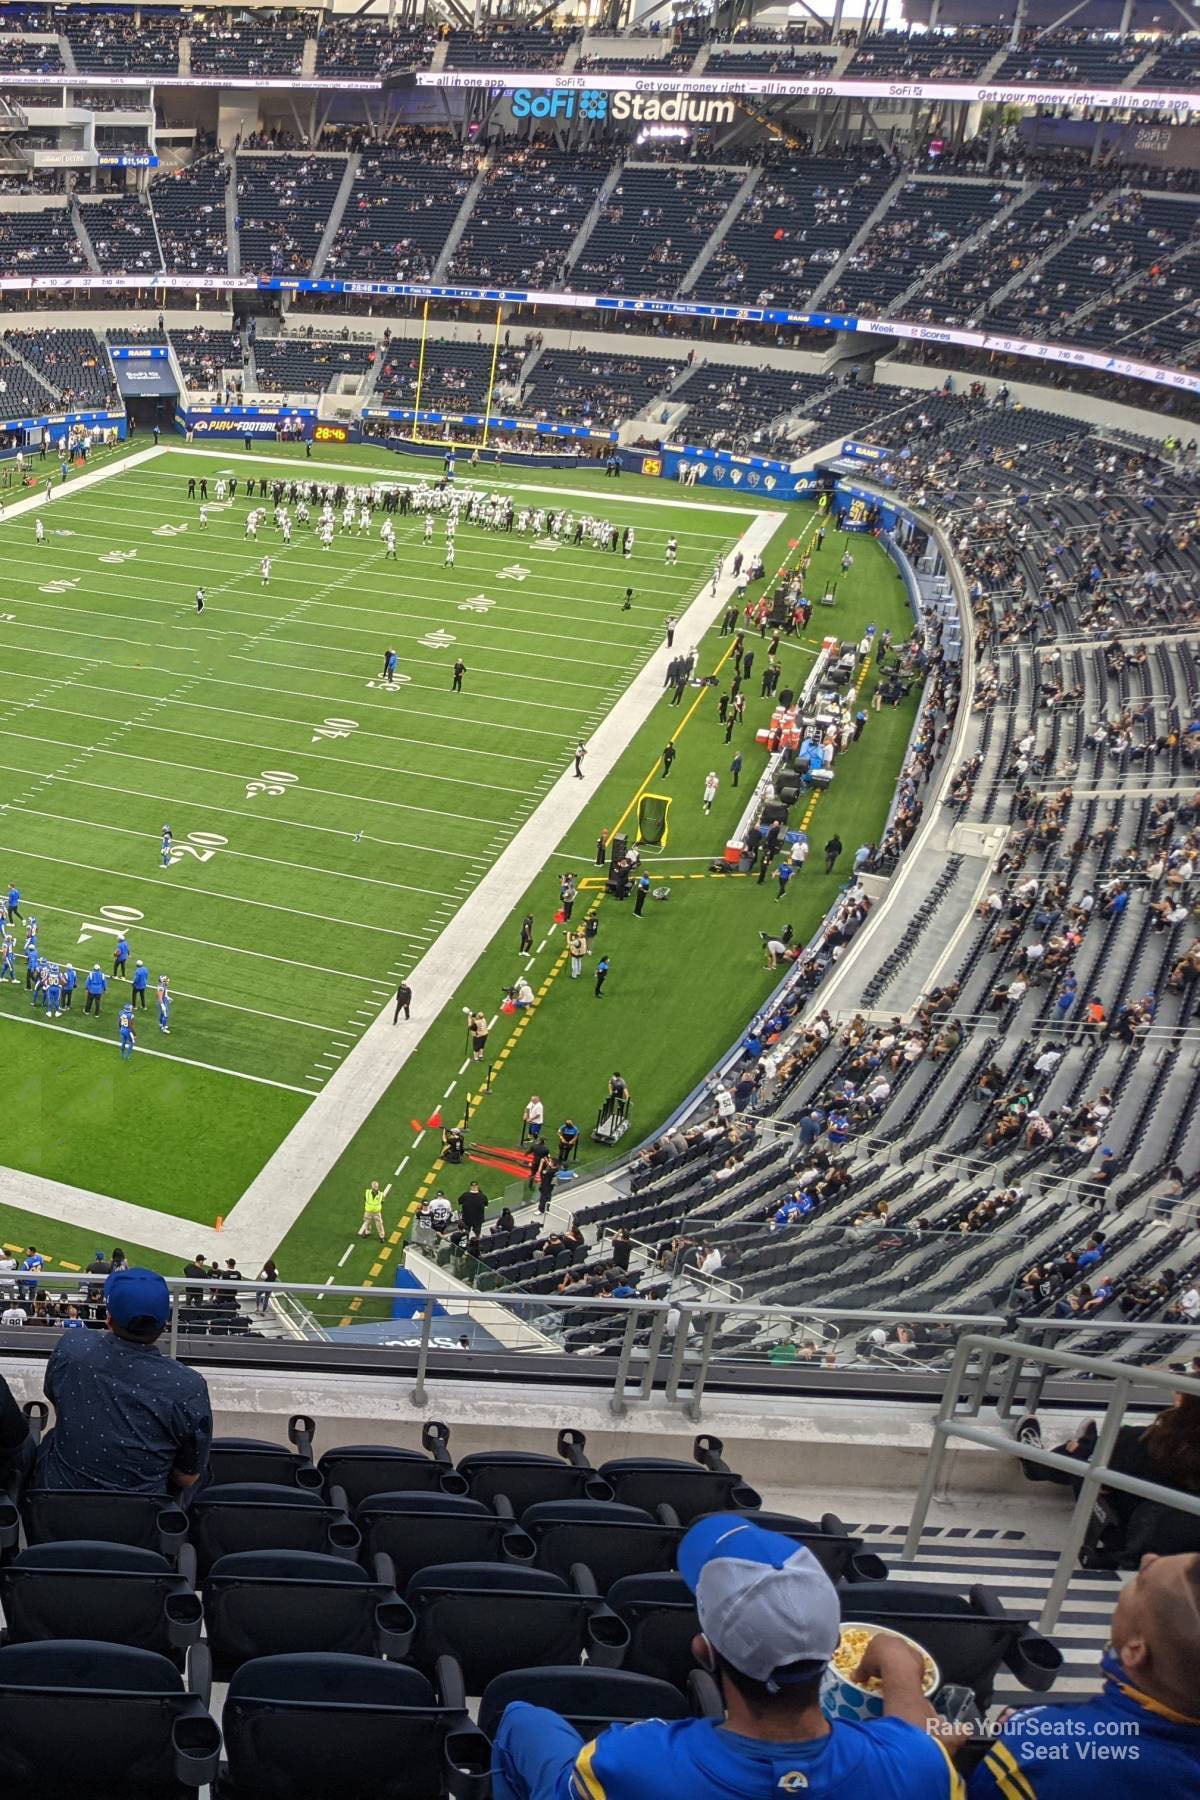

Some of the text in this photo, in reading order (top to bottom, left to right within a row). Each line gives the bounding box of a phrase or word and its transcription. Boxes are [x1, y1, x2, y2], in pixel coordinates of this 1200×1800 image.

[436, 76, 449, 86] all
[463, 78, 482, 87] one
[555, 77, 575, 87] SoFi
[635, 81, 654, 90] Get
[657, 82, 681, 92] your
[683, 83, 717, 92] money
[720, 82, 746, 93] right
[761, 83, 774, 93] all
[776, 84, 786, 93] in
[789, 85, 809, 94] one
[889, 86, 911, 95] SoFi
[978, 89, 996, 99] Get
[1000, 91, 1024, 102] your
[1027, 93, 1063, 104] money
[1067, 93, 1095, 106] right
[1111, 96, 1125, 105] all
[1141, 98, 1161, 108] one
[512, 88, 735, 122] SoFi Stadium
[870, 322, 950, 341] Week Scores
[315, 427, 345, 440] 28:46
[855, 446, 879, 458] RAMS
[644, 460, 659, 473] 25
[313, 718, 359, 739] 40
[246, 770, 299, 796] 30
[170, 832, 229, 862] 20
[80, 905, 145, 936] 10
